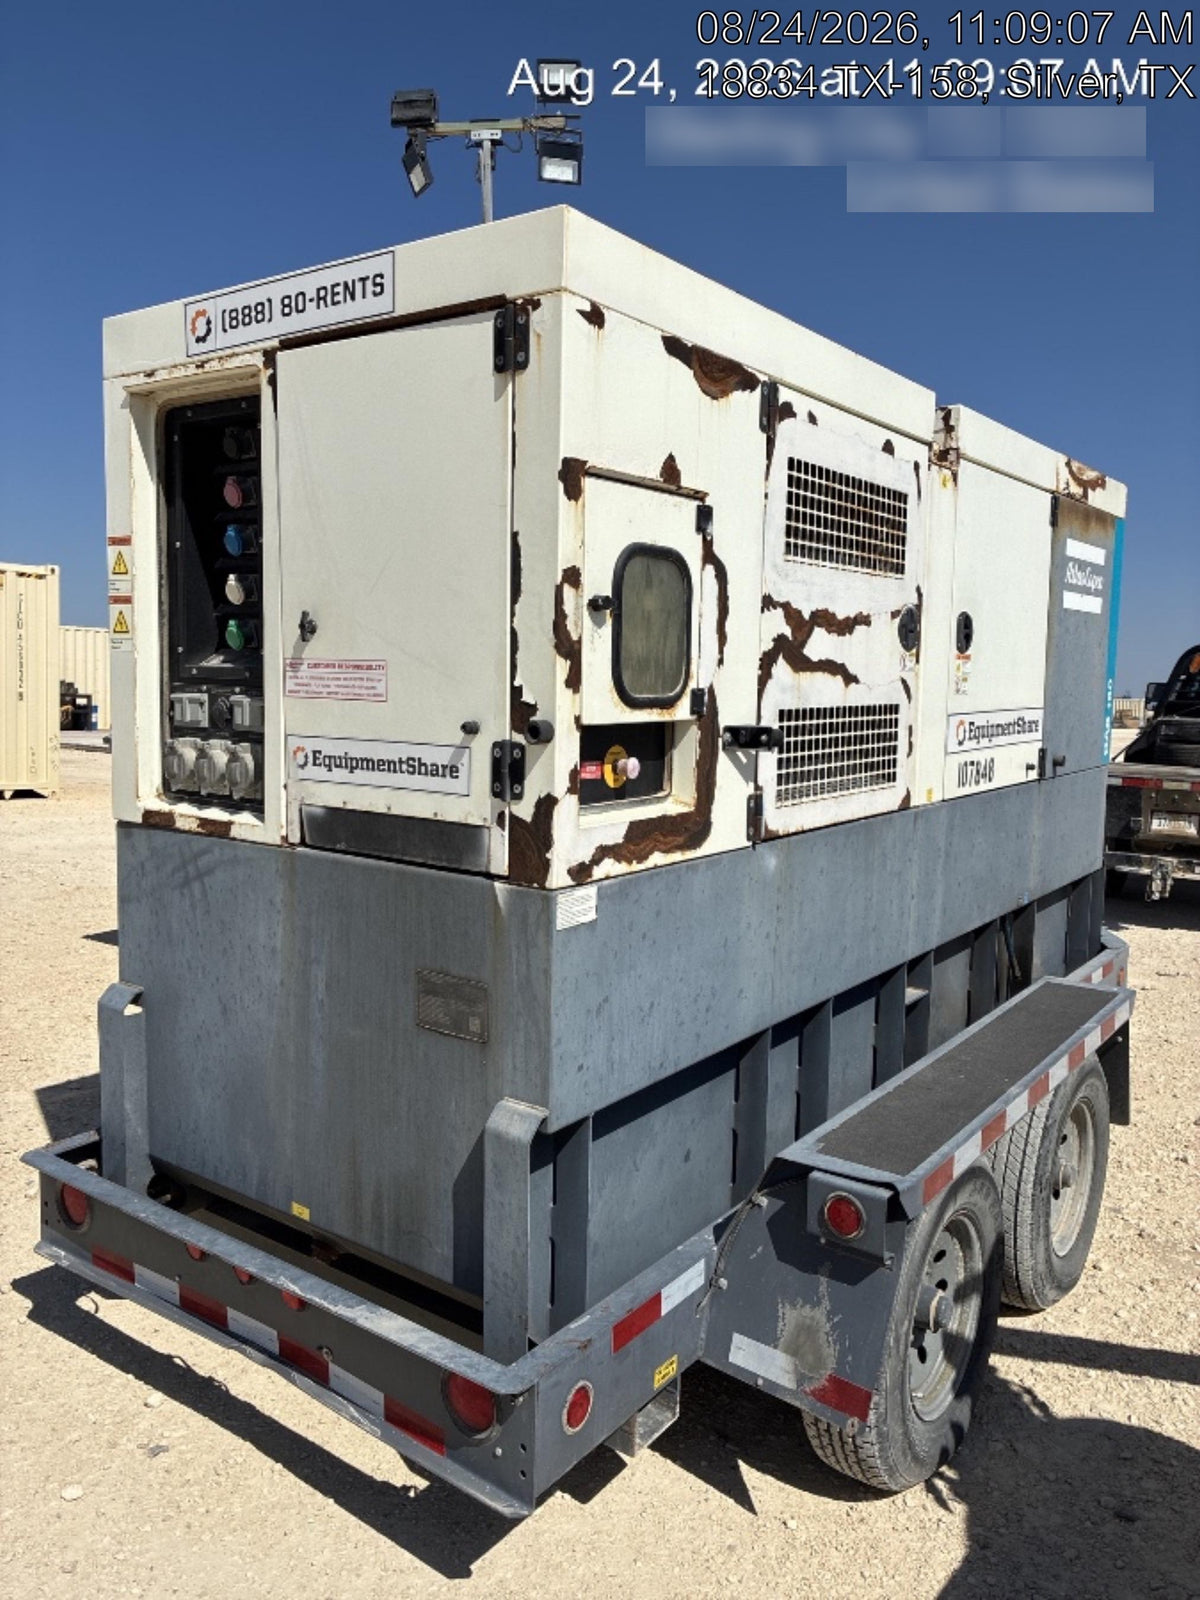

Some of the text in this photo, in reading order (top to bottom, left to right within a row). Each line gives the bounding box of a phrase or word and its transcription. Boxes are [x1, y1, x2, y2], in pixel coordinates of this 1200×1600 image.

[221, 272, 385, 333] (888) 80-RENTS
[968, 716, 1039, 744] EquipmentShare
[312, 750, 459, 779] EquipmentShare
[957, 757, 995, 788] 107848
